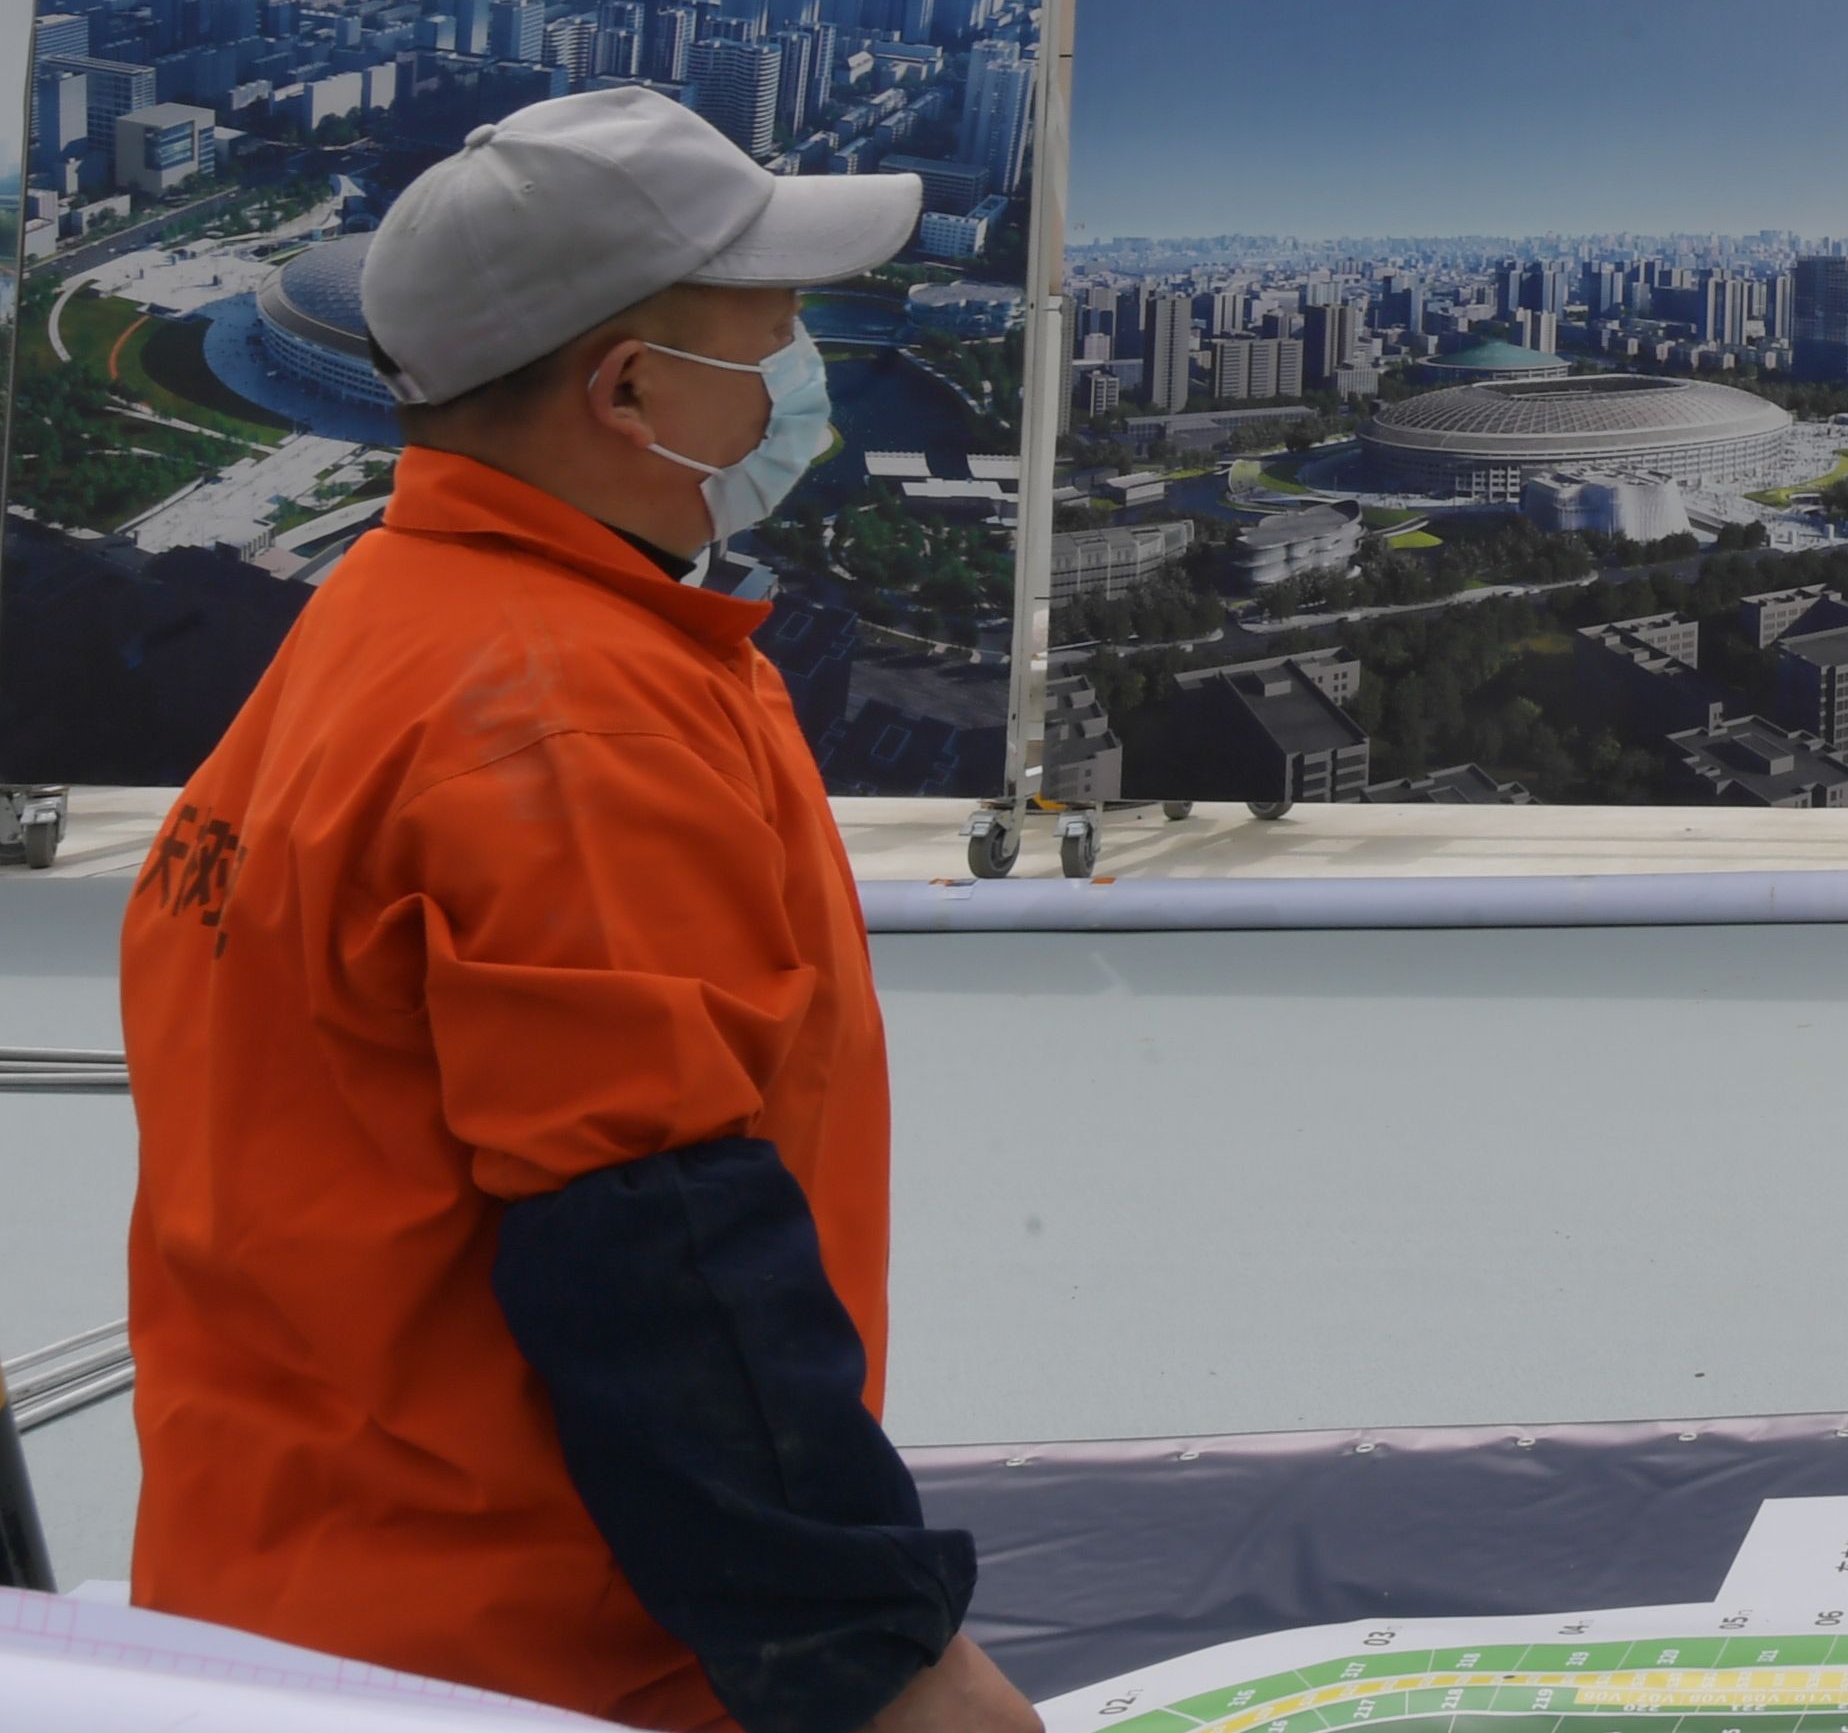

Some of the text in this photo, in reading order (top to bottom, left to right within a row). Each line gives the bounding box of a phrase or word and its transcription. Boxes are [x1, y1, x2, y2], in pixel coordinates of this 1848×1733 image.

[1814, 1610, 1844, 1627] 06
[1566, 1650, 1590, 1667] 319
[1228, 1687, 1252, 1708] 316
[1441, 1688, 1464, 1709] 218
[1532, 1688, 1554, 1710] 219
[1353, 1698, 1379, 1720] 217
